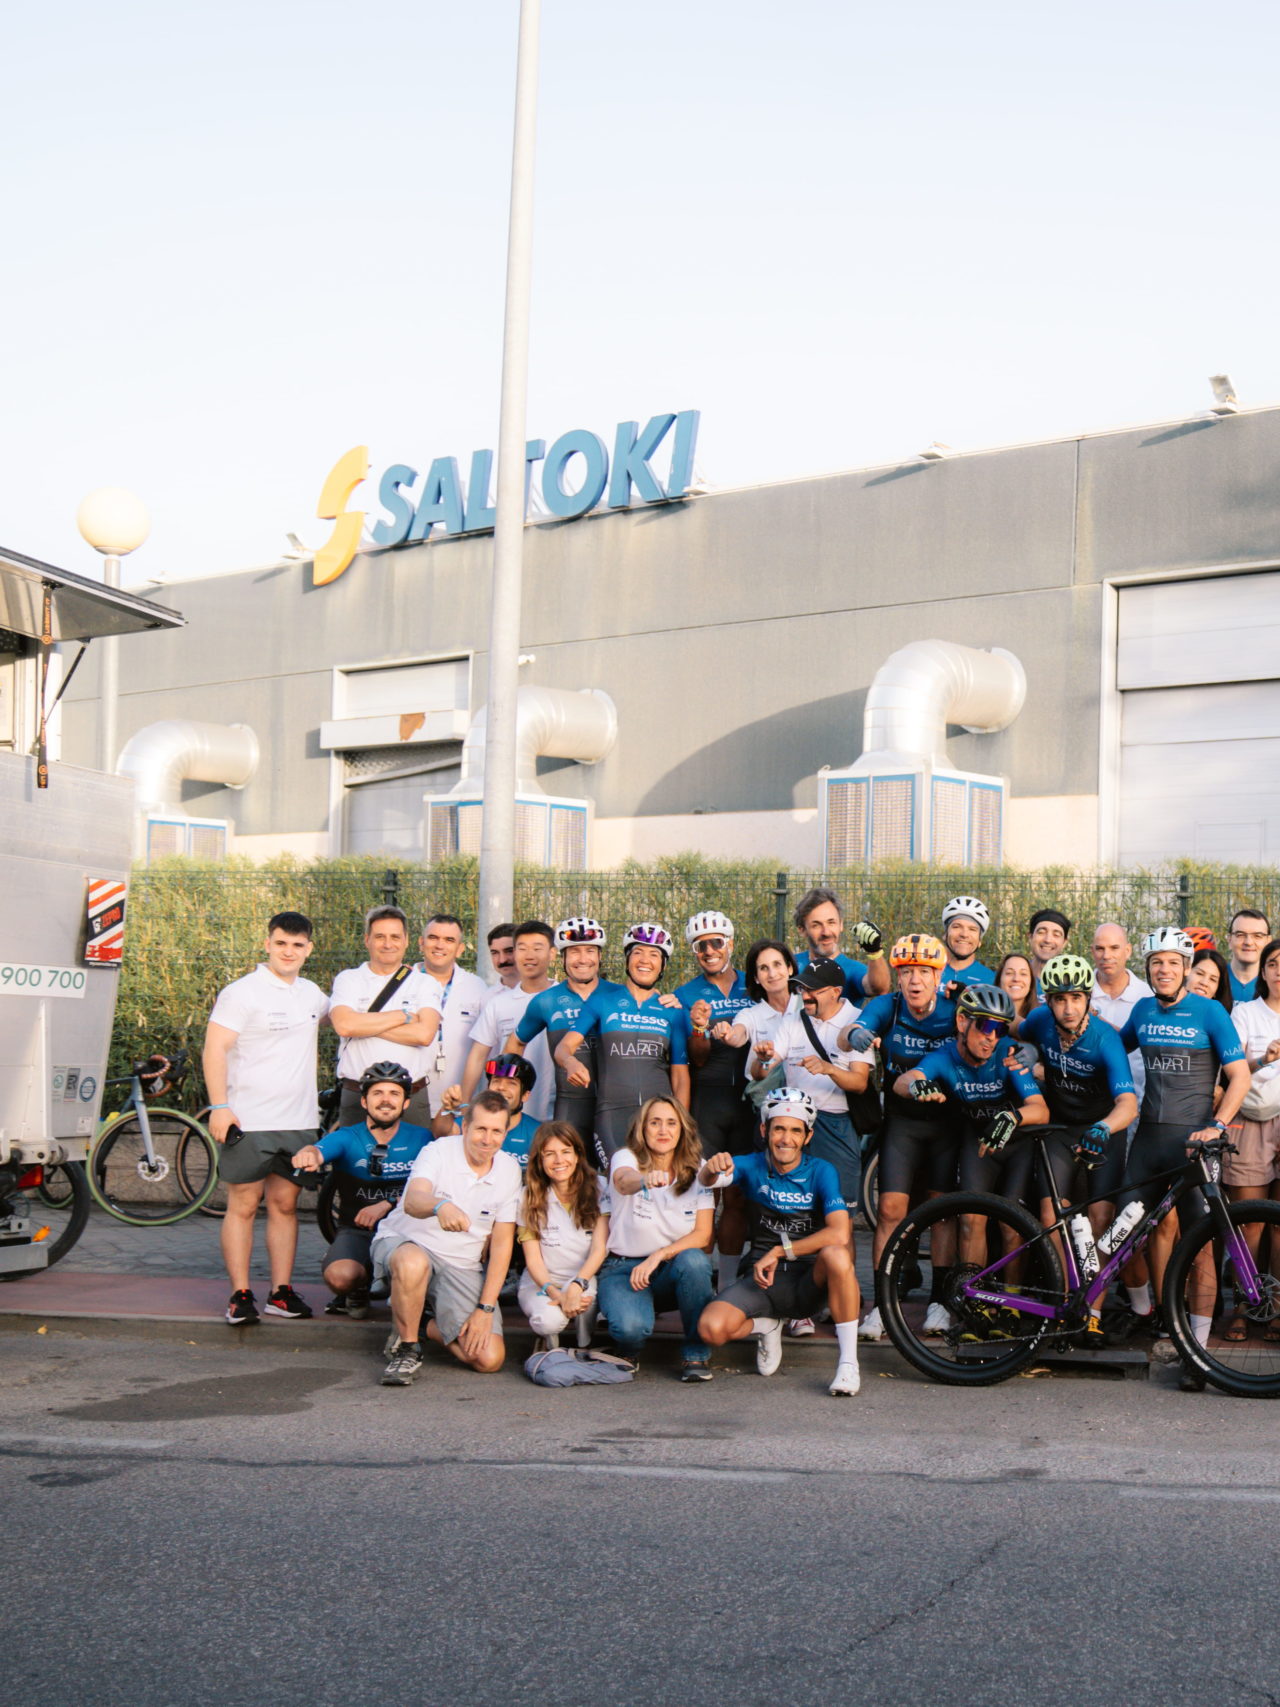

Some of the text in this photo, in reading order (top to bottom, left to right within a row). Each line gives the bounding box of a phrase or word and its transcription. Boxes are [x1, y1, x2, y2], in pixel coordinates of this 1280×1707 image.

[1, 967, 85, 989] 900 700
[975, 1292, 1008, 1304] SCOTT
